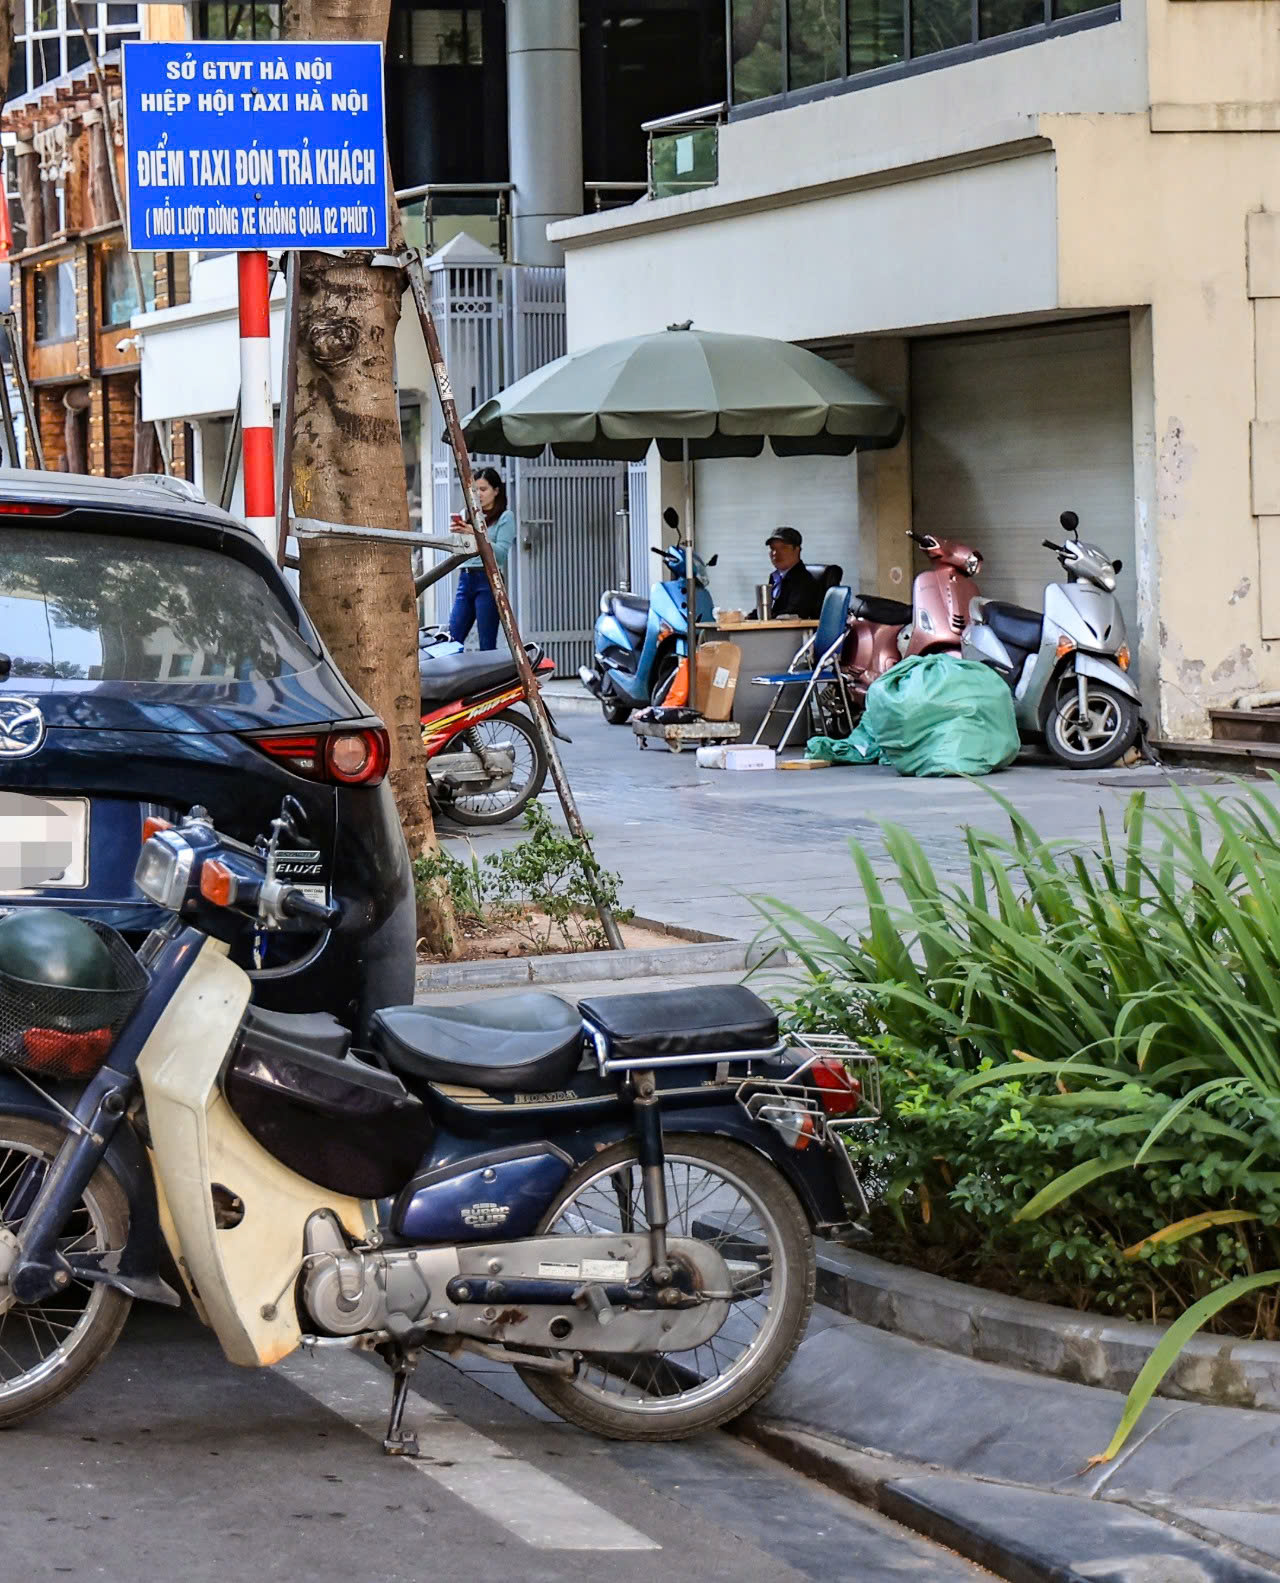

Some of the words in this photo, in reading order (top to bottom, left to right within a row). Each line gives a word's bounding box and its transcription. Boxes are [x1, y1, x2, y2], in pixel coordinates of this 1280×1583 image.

[166, 52, 198, 80] SỞ
[202, 61, 254, 80] GTVT
[259, 57, 290, 80] HÀ
[295, 57, 333, 85] NỘI
[140, 89, 191, 116] HIỆP
[197, 89, 235, 116] HỘI
[240, 92, 289, 112] TAXI
[295, 89, 325, 112] HÀ
[331, 89, 369, 116] NỘI
[137, 132, 185, 187] ĐIỂM
[189, 149, 231, 187] TAXI
[235, 140, 274, 186] ĐÓN
[278, 137, 317, 185] TRẢ
[316, 141, 376, 185] KHÁCH
[177, 204, 206, 242] LƯỢT
[207, 200, 239, 235] DỪNG
[241, 207, 257, 235] XE
[258, 200, 297, 235] KHÔNG
[323, 206, 338, 235] 02
[275, 863, 323, 874] ELUXE
